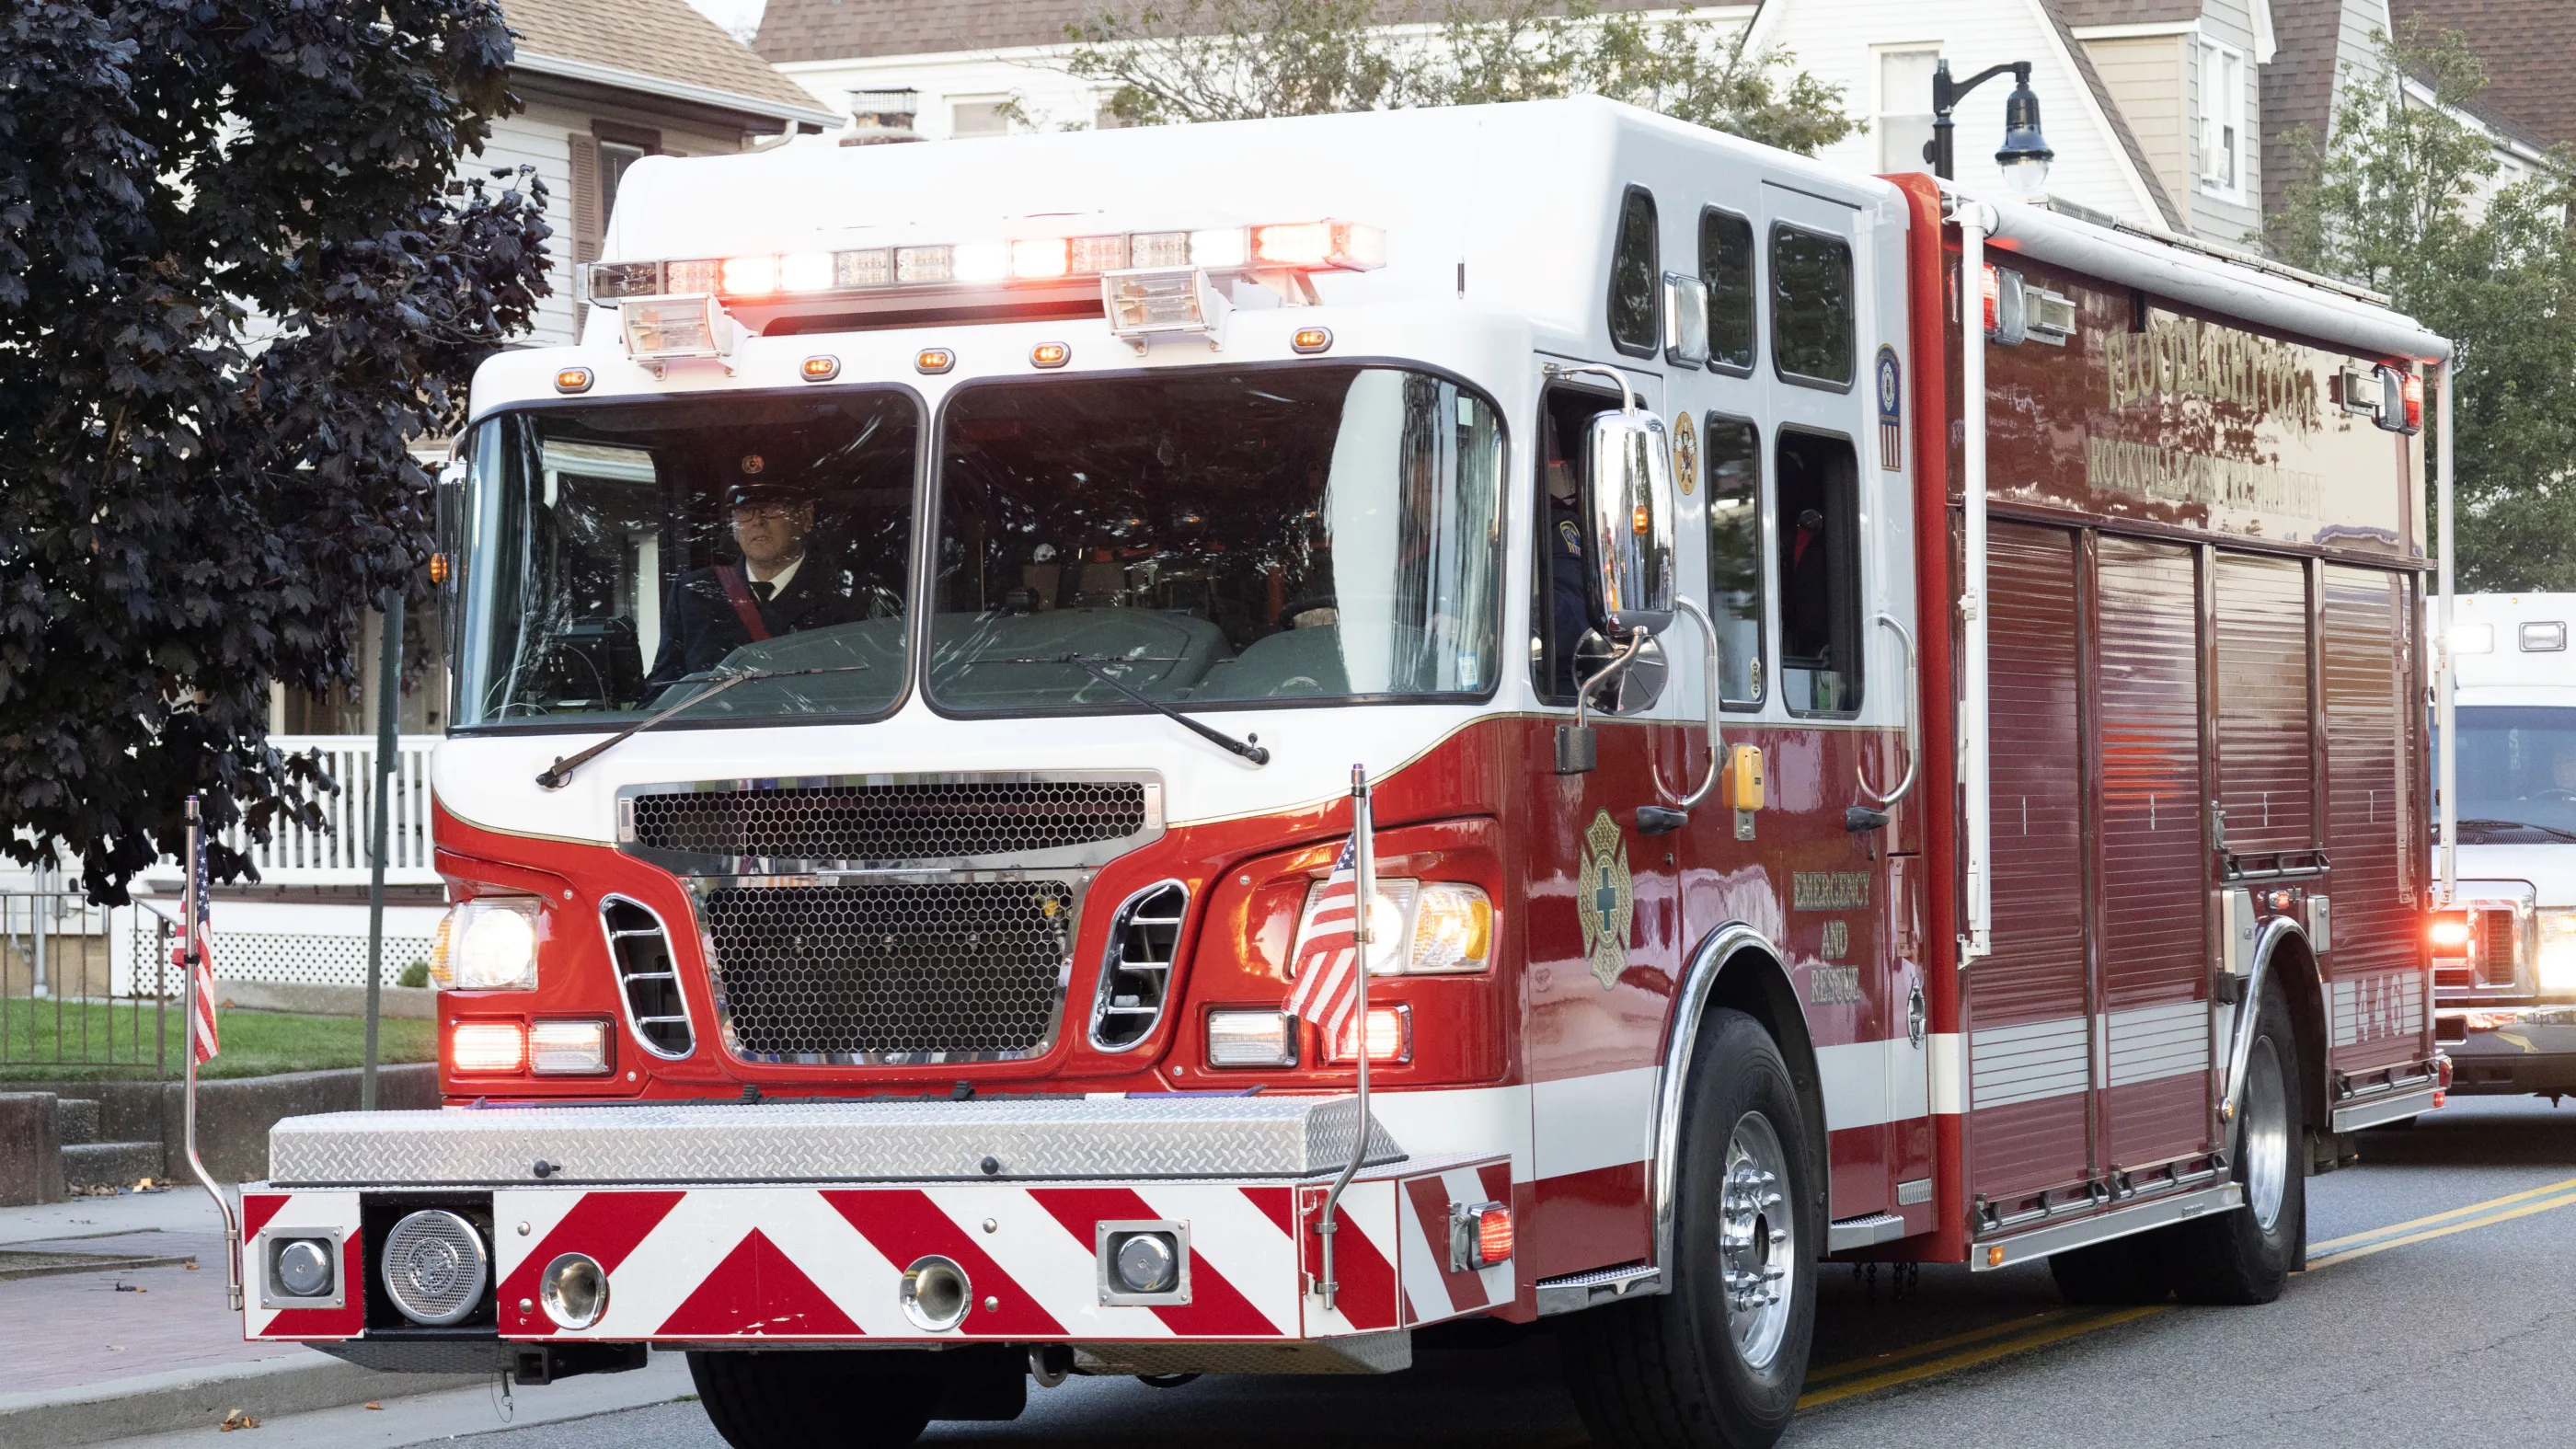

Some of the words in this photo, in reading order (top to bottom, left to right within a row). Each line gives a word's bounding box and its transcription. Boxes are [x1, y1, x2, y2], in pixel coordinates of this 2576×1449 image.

[2105, 319, 2262, 413] FLOODLIGHT
[2088, 436, 2186, 500] ROCKVILLE
[2189, 452, 2251, 511] CENTRE
[2253, 464, 2287, 517] FIRE
[1793, 871, 1870, 911] EMERGENCY
[1821, 920, 1848, 960] AND
[1811, 966, 1860, 1006] RESCUE
[2357, 972, 2403, 1041] 446
